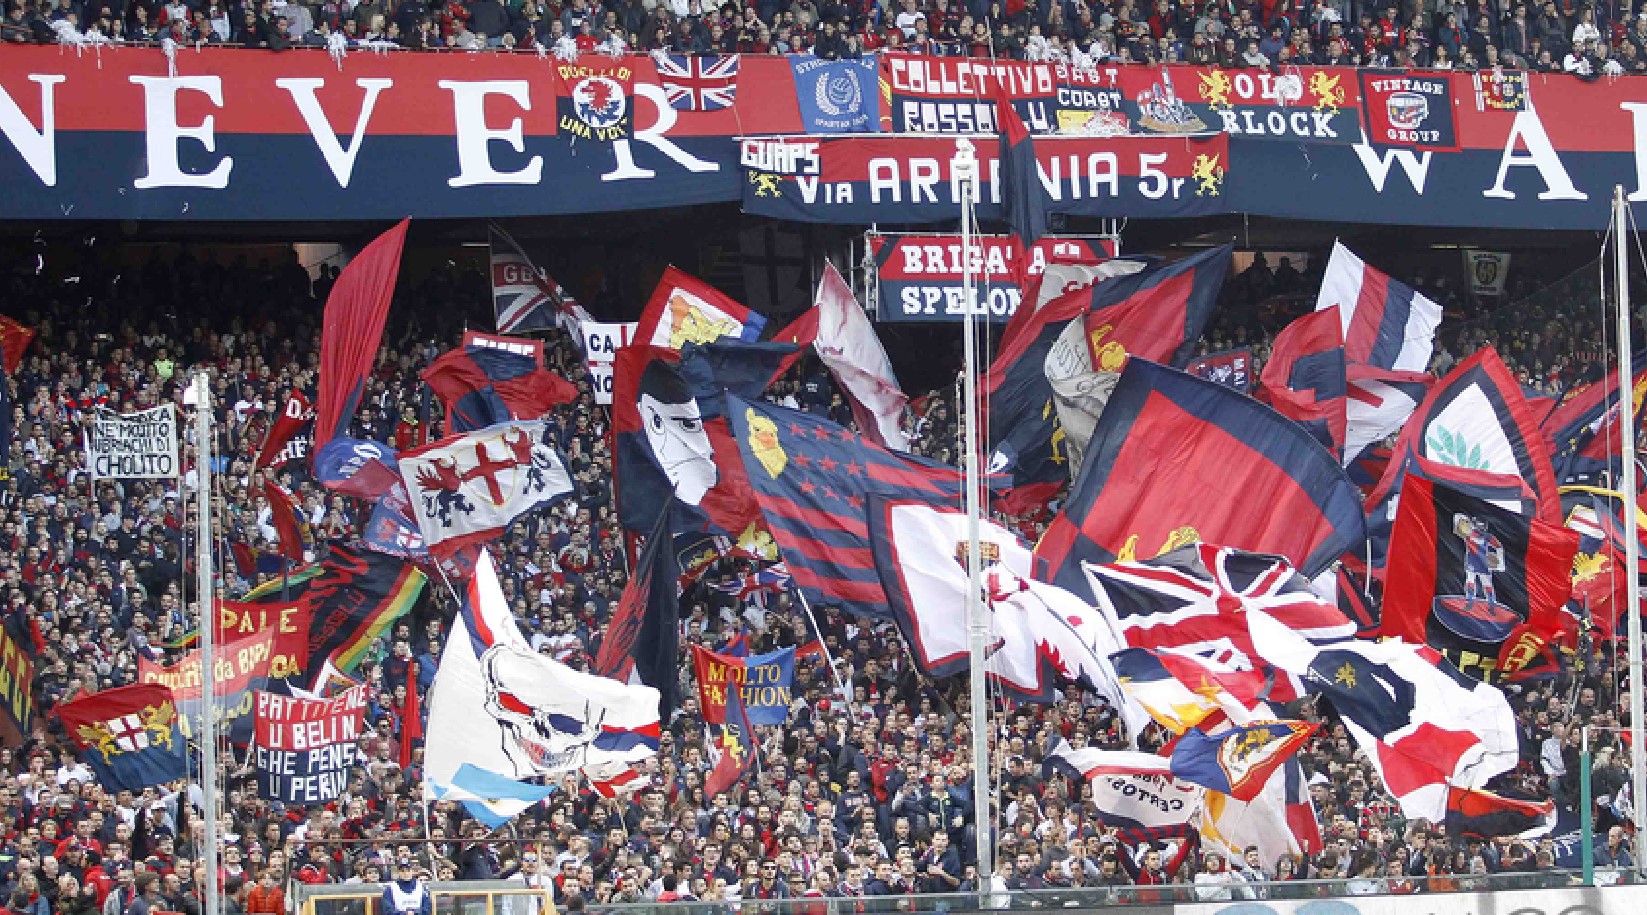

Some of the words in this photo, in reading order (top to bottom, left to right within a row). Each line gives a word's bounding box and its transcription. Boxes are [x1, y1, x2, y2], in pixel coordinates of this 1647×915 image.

[890, 58, 1052, 96] COLLETTIVO
[1371, 79, 1444, 96] VINTAGE
[1058, 88, 1122, 109] COAST
[1217, 109, 1338, 138] BLOCK
[1387, 128, 1440, 143] GROUP
[795, 174, 854, 204] VIA
[1138, 152, 1185, 201] 5r
[900, 243, 1047, 274] BRIGAA
[96, 453, 172, 477] CHOLITO
[703, 684, 792, 707] FAHION
[269, 722, 283, 748] U
